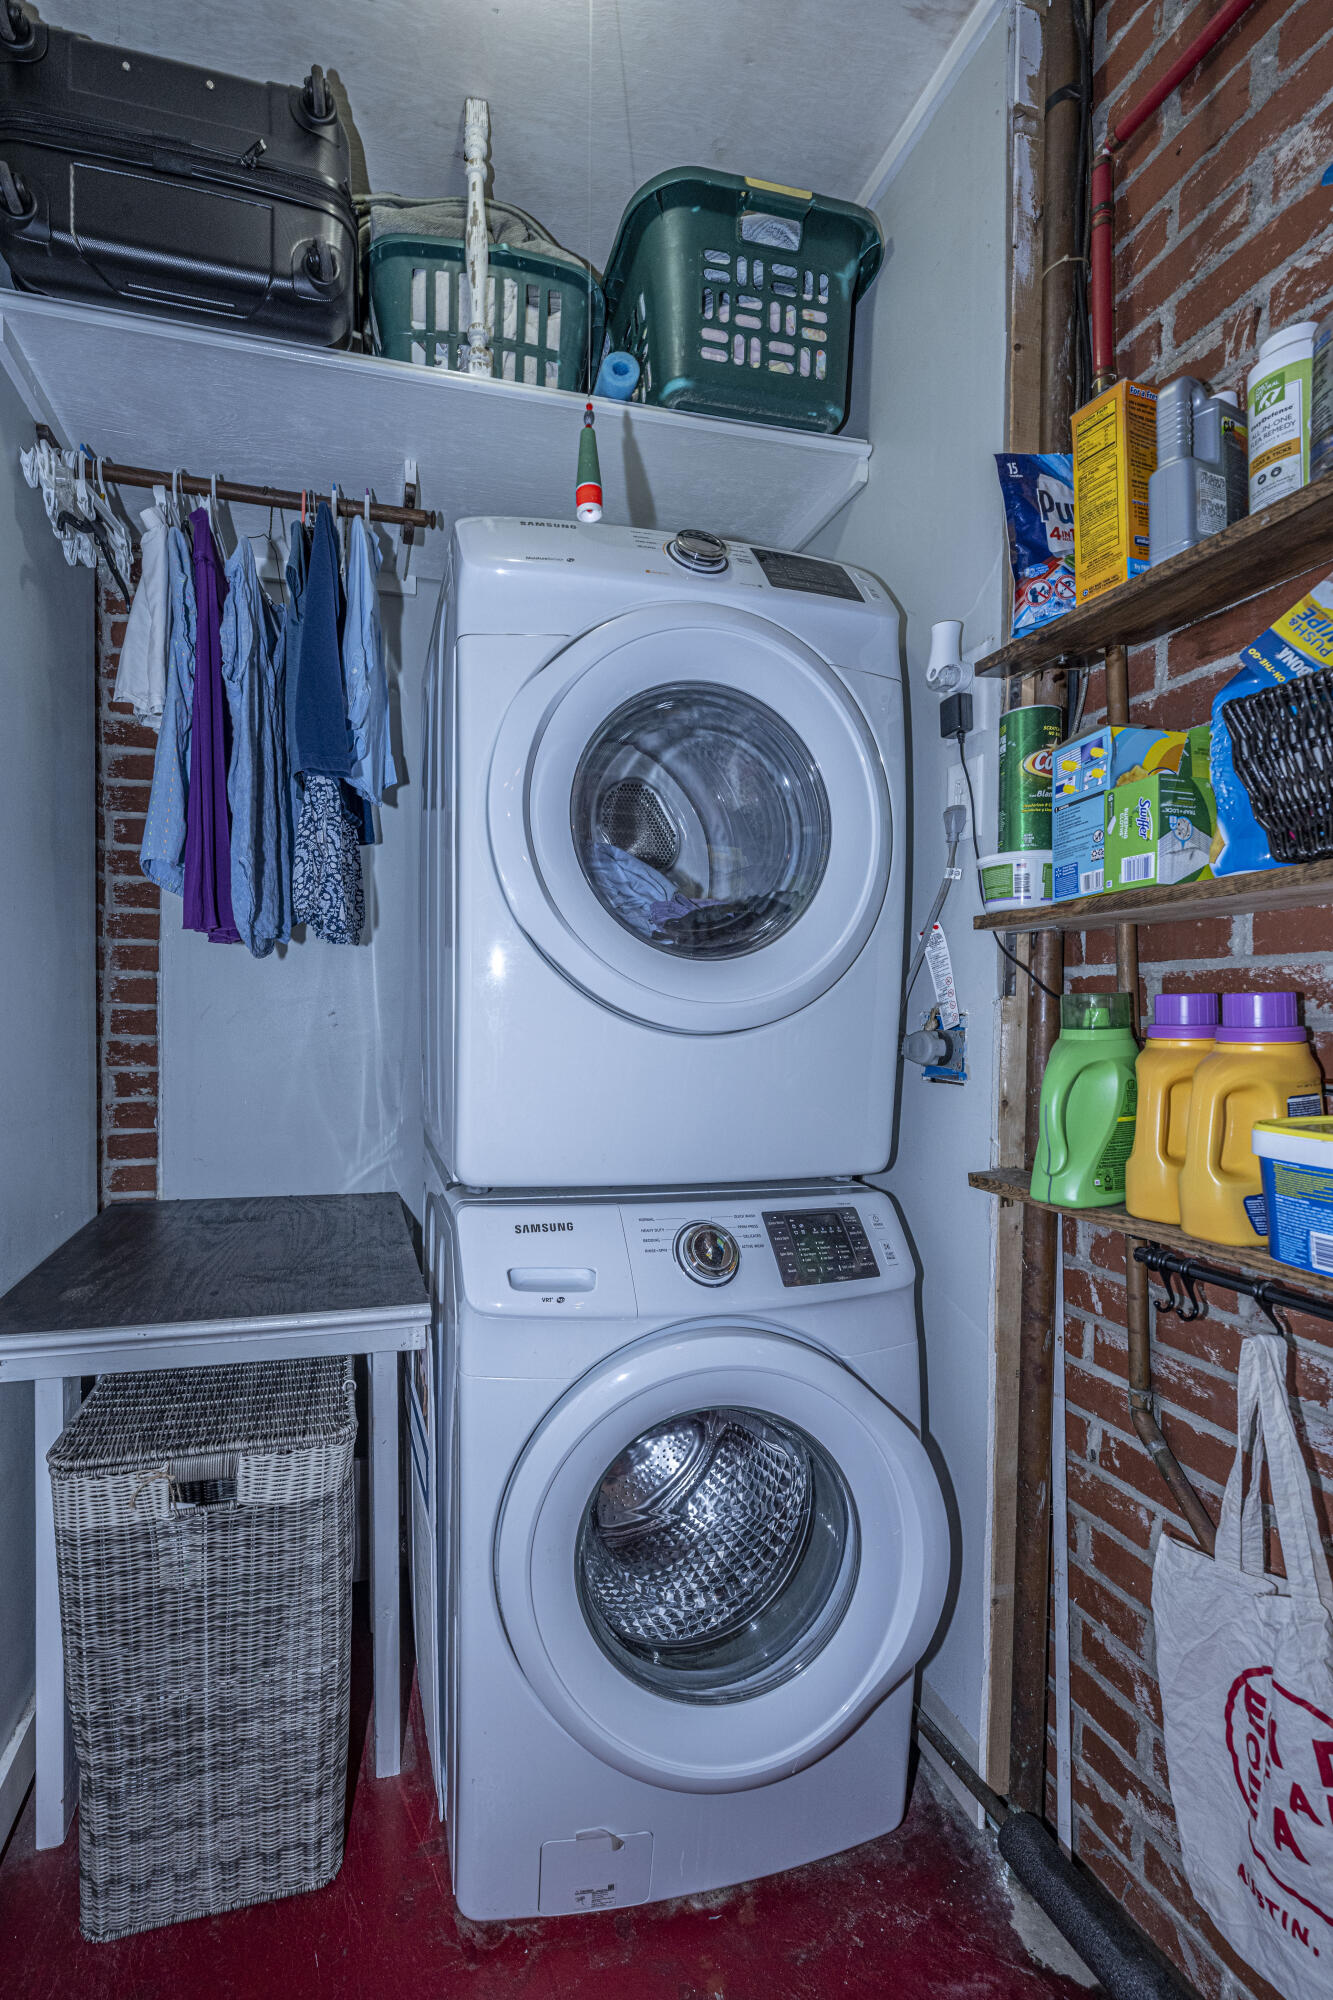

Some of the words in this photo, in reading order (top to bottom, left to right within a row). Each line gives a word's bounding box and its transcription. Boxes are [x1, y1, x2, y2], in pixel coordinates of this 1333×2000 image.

[1129, 385, 1141, 396] For
[1141, 389, 1146, 397] a
[1263, 420, 1296, 439] REMEDY
[1006, 462, 1018, 475] 15
[520, 521, 577, 530] SAMSUNG
[1136, 797, 1151, 840] Swiffer
[514, 1222, 574, 1234] SAMSUNG
